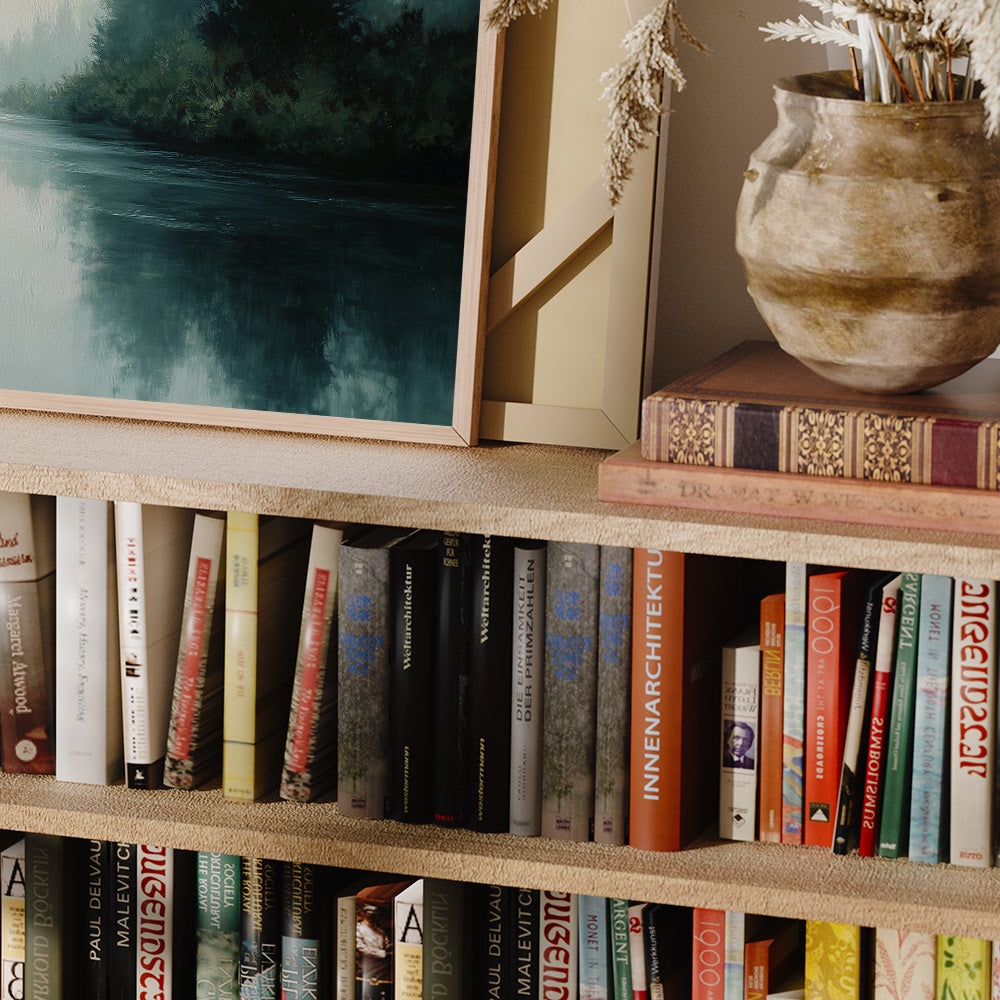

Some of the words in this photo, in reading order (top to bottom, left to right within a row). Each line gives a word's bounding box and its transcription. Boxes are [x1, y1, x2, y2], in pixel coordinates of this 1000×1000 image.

[6, 594, 27, 659] Margaret
[403, 563, 413, 671] Weltarchitektur
[516, 575, 526, 699] EINSAMKEIT
[525, 558, 535, 681] PRIMZAHLEN
[13, 659, 33, 715] Atwood
[524, 684, 532, 723] DER
[643, 549, 664, 801] INNENARCHITEKTU
[516, 702, 524, 722] DIE
[402, 745, 410, 814] westermann
[477, 737, 486, 821] westermann
[88, 912, 102, 961] PAUL
[587, 913, 599, 952] MONET
[650, 925, 659, 975] Werkkunst
[694, 920, 721, 987] 1900
